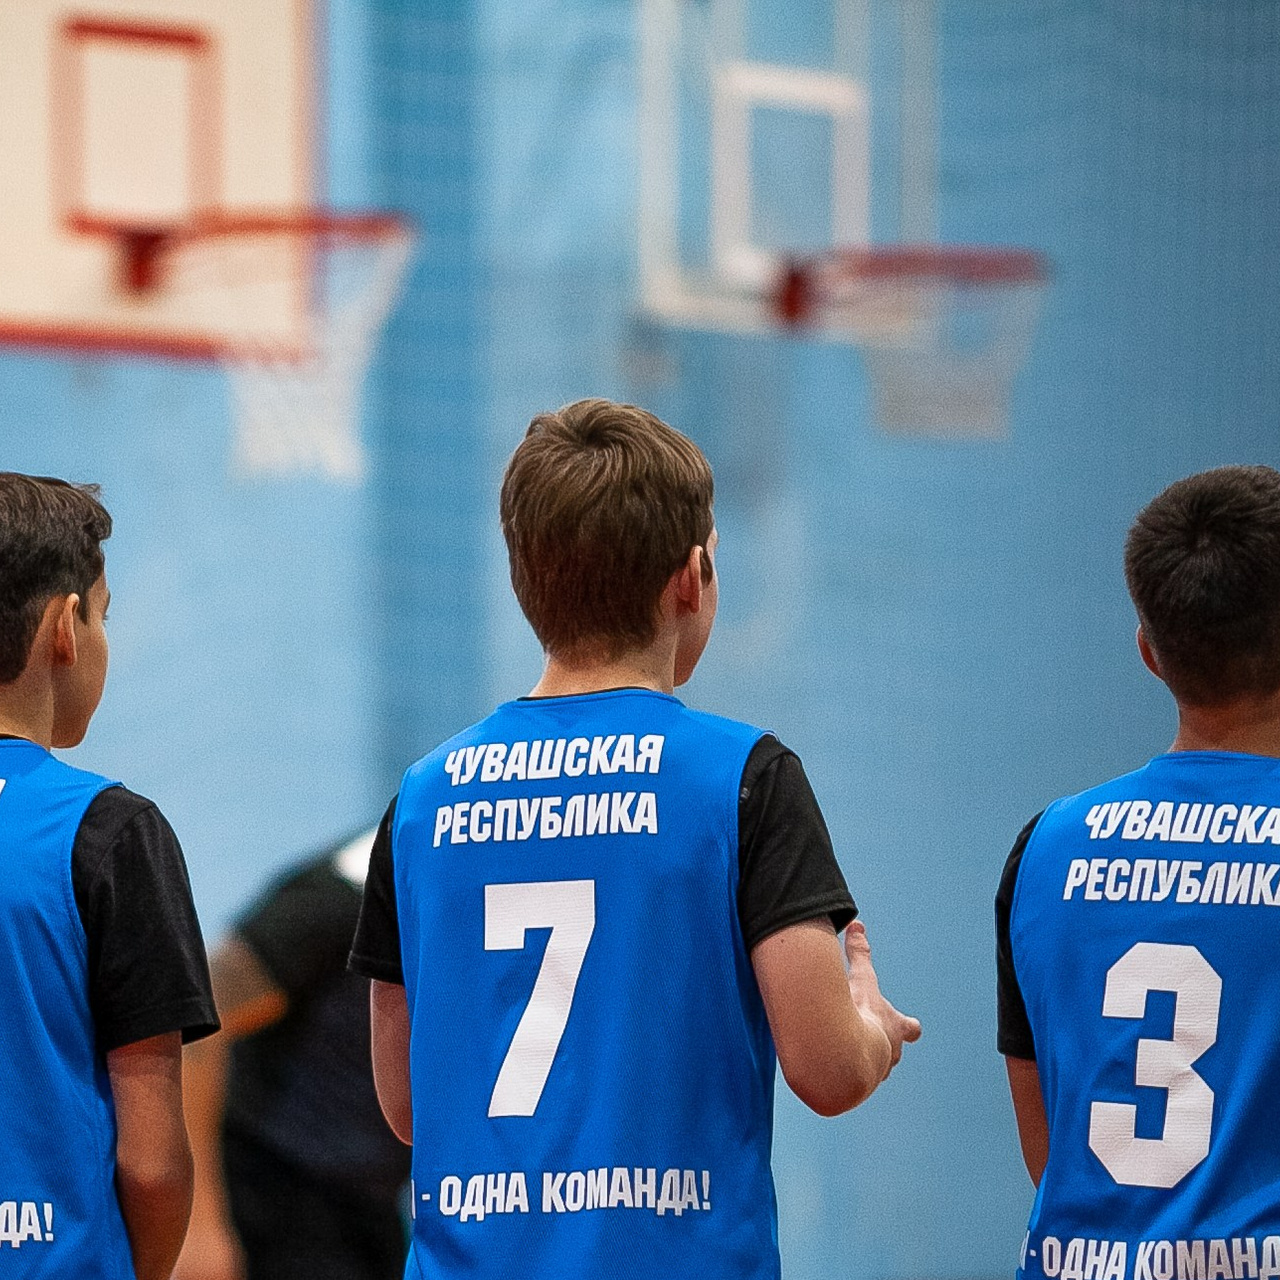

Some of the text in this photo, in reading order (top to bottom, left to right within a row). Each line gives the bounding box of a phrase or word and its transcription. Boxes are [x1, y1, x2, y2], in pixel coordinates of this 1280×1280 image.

[444, 734, 665, 787] ЧУВАШСКАЯ
[432, 791, 658, 848] РЕСПУБЛИКА
[1062, 858, 1280, 907] РЕСПУБЛИК
[484, 879, 596, 1118] 7
[1086, 941, 1223, 1189] 3
[439, 1172, 530, 1223] ОДНА
[542, 1167, 711, 1216] КОМАНДА!
